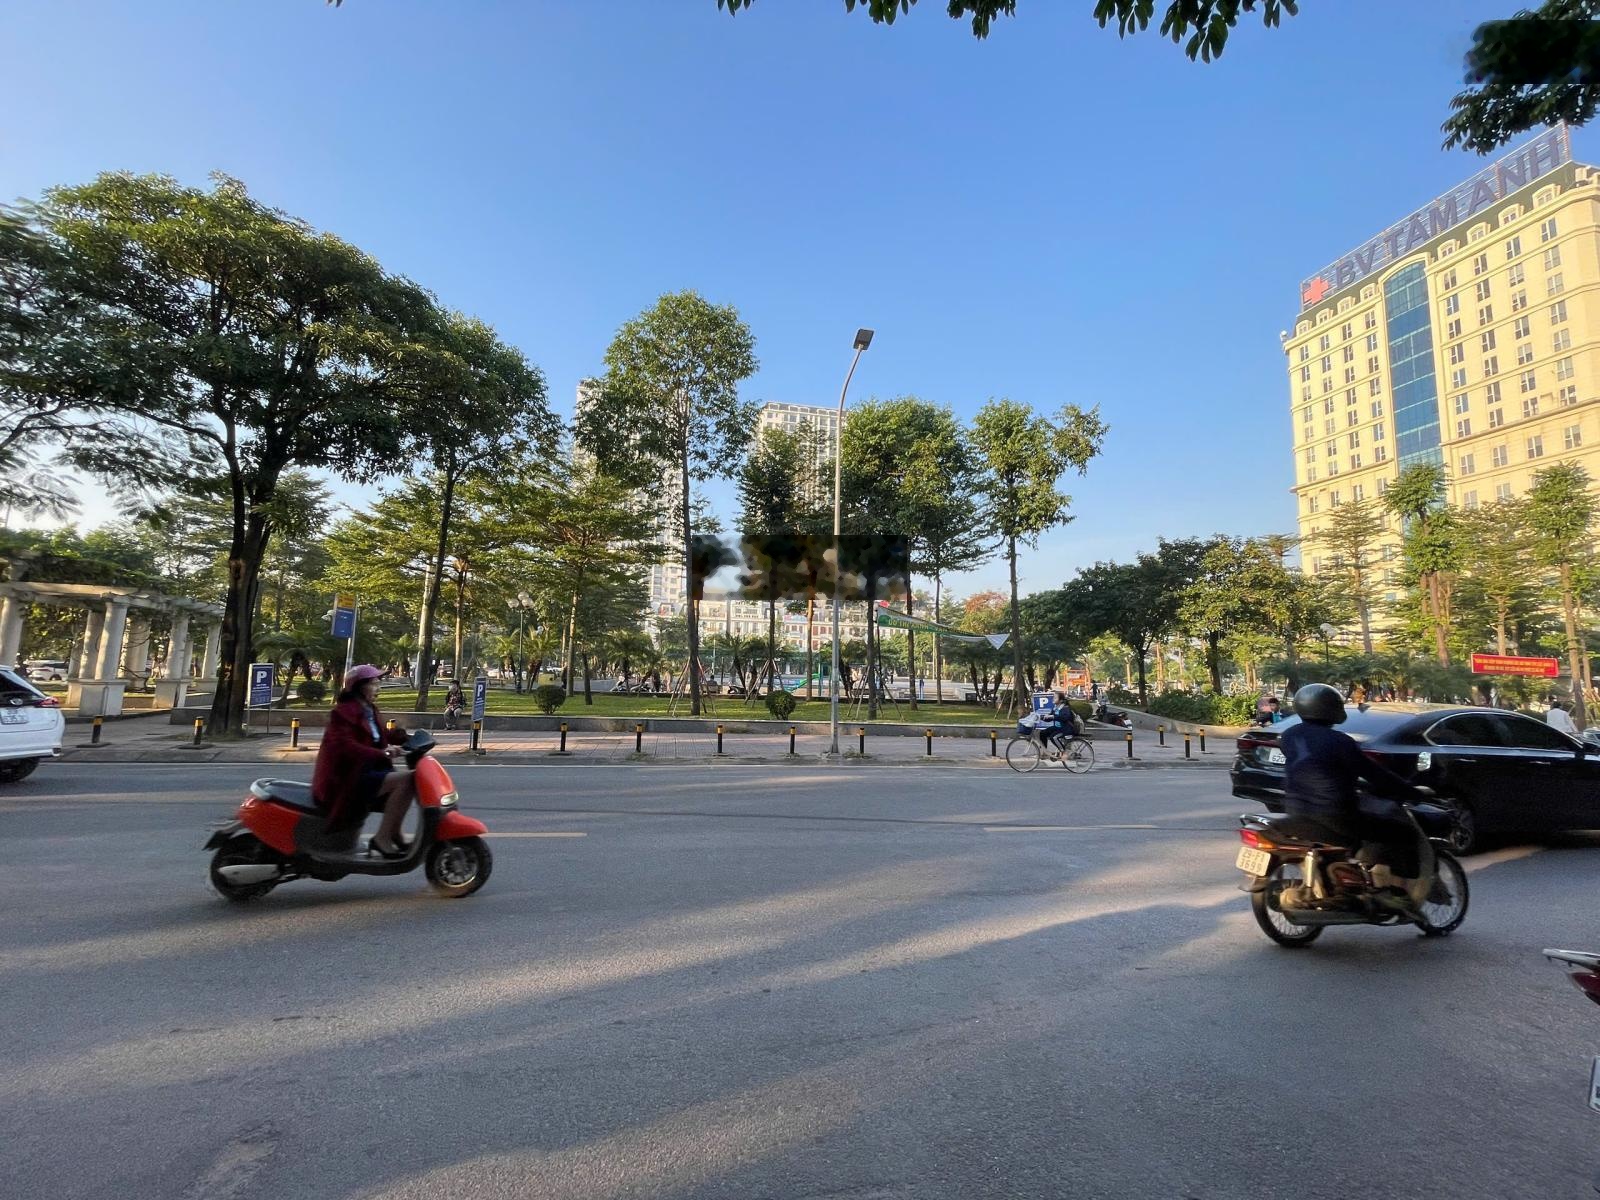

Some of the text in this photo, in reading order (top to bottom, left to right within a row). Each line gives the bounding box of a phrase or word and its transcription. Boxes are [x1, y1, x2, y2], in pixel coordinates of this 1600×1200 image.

[1336, 133, 1560, 290] BV TÂM ANH
[256, 670, 268, 684] P
[477, 684, 484, 697] P
[1039, 697, 1049, 708] P
